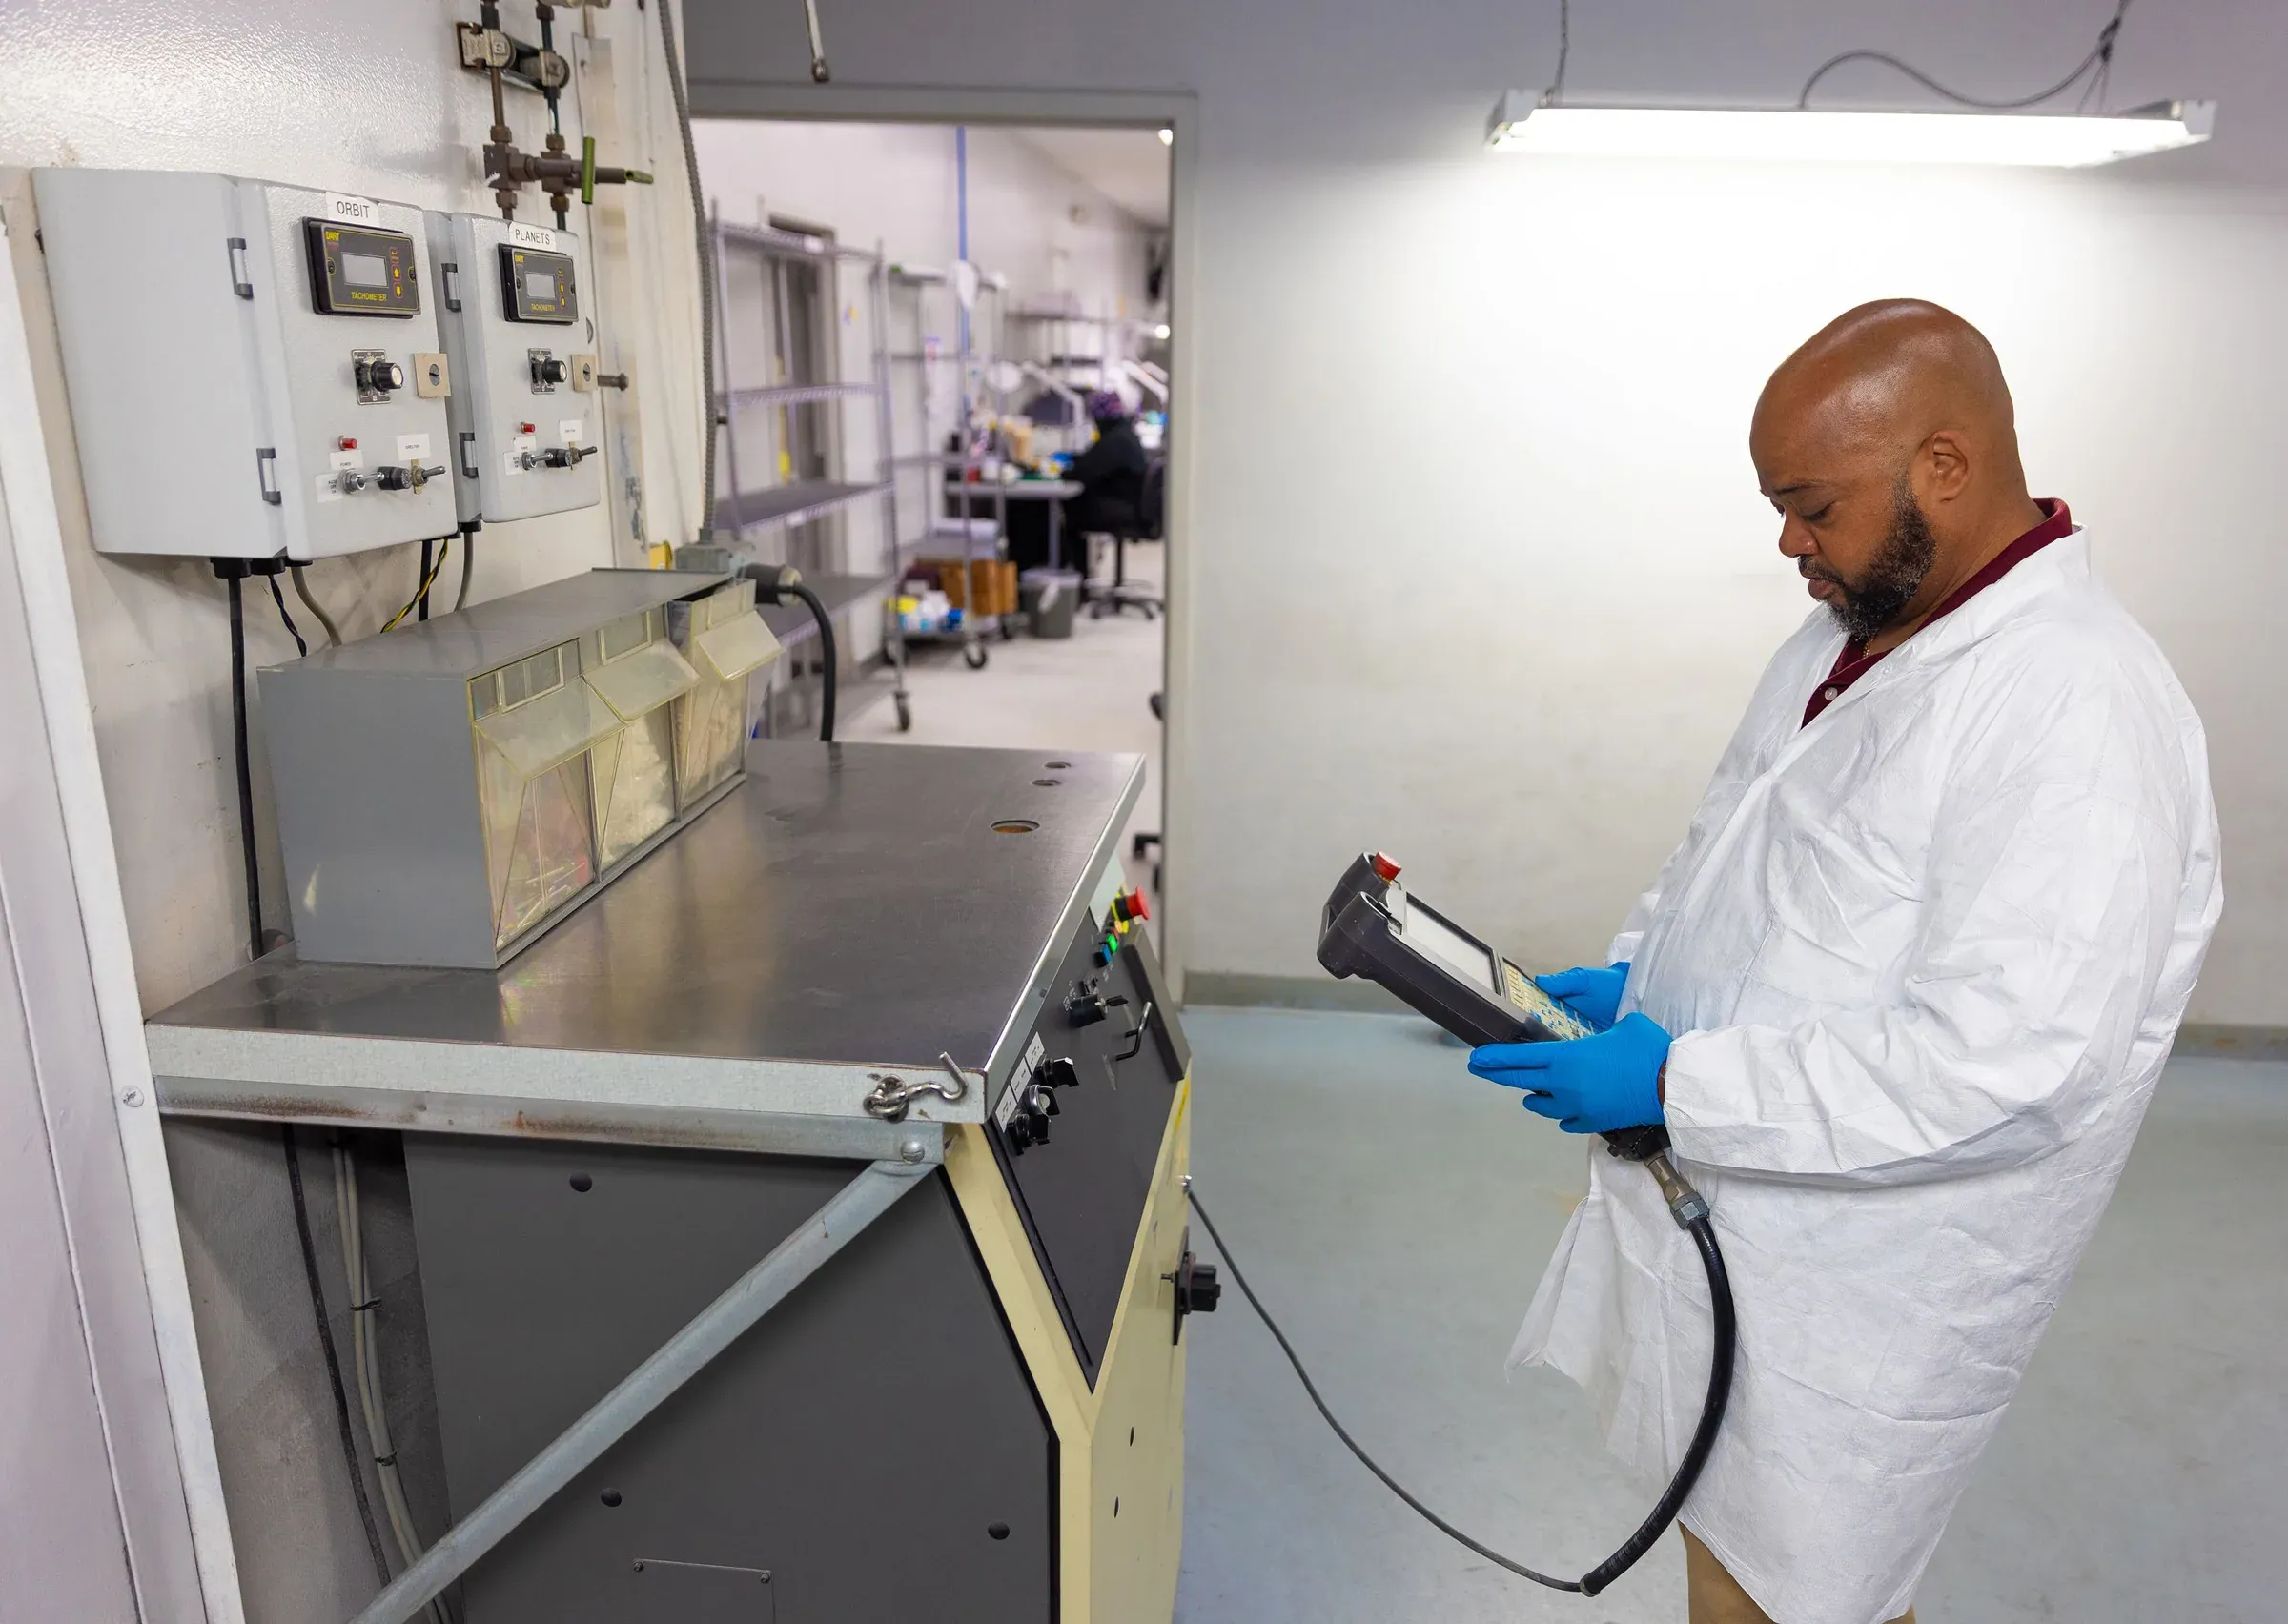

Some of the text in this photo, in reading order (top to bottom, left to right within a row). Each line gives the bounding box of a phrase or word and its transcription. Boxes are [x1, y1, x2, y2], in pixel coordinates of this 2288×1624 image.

[337, 201, 369, 218] ORBIT
[515, 229, 550, 245] PLANETS
[351, 291, 387, 302] TACHOMETER
[530, 303, 555, 312] TACHOMETER
